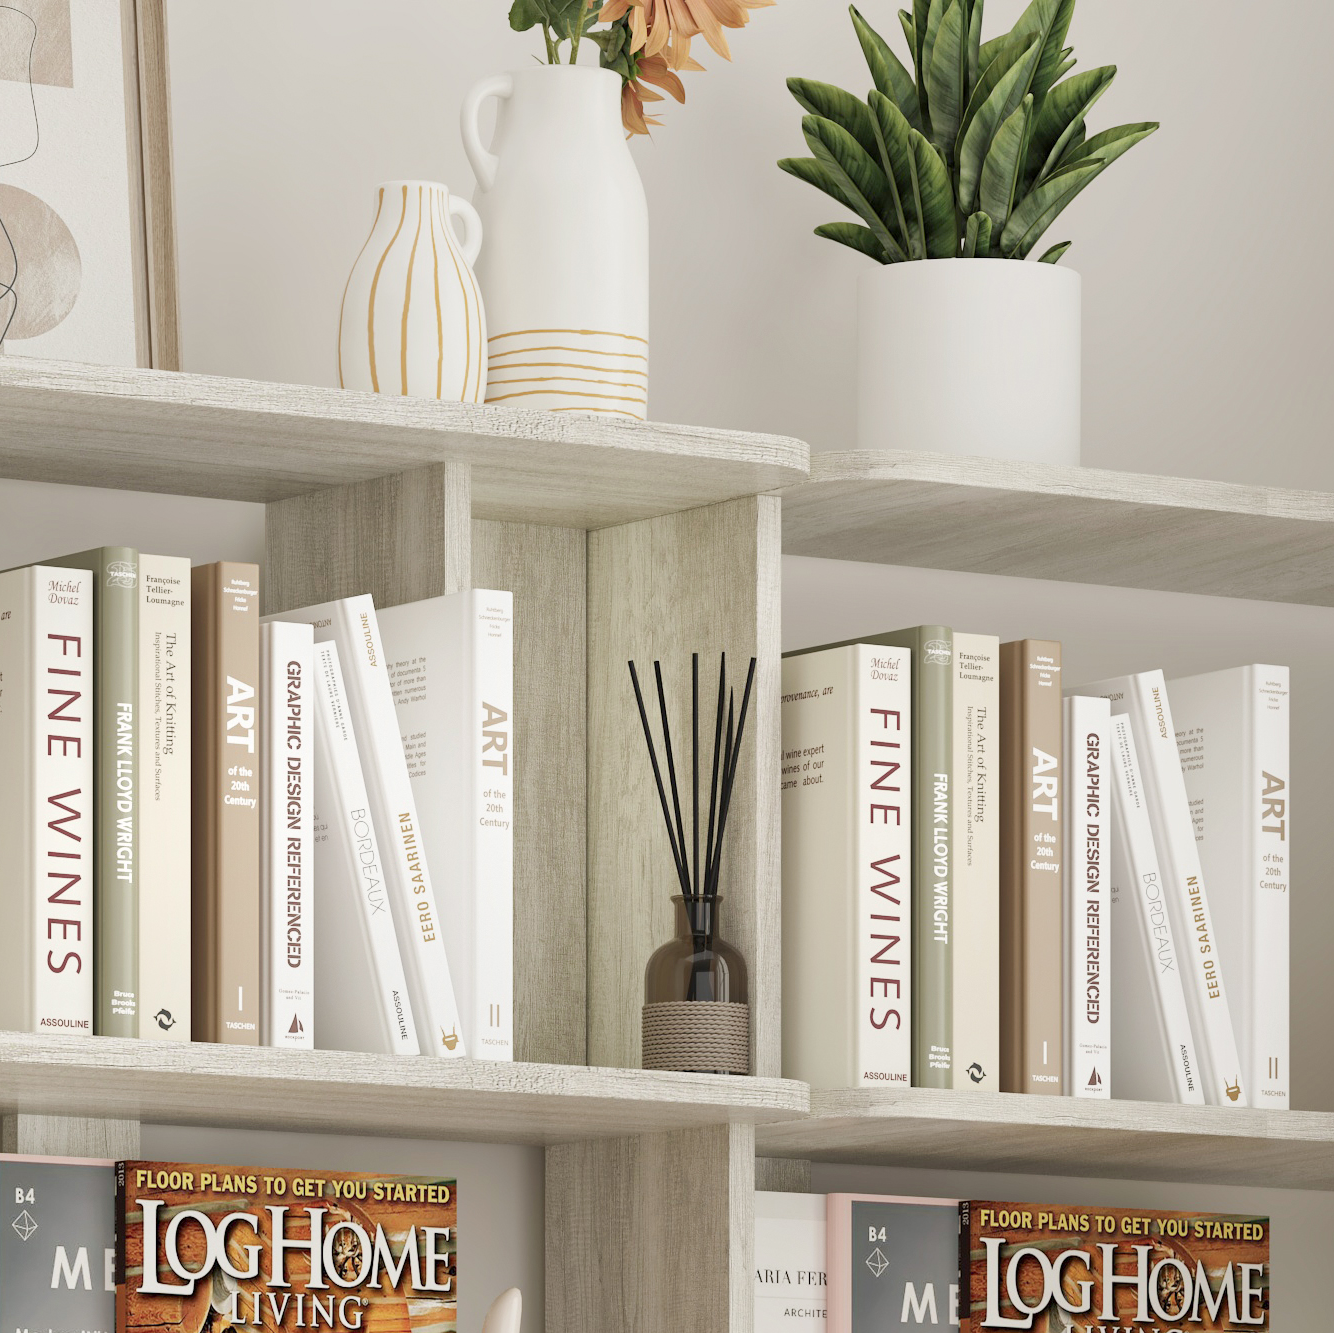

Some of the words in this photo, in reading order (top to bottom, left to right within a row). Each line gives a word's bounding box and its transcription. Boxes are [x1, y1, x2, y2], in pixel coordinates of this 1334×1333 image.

[48, 580, 82, 593] Michel
[48, 593, 79, 606] Dovaz
[146, 575, 181, 586] Françoise
[146, 596, 185, 607] Loumagne
[166, 632, 177, 657] The
[166, 660, 177, 682] Art
[47, 633, 82, 758] FINE
[166, 684, 177, 701] of
[226, 675, 255, 754] ART
[287, 661, 301, 750] GRAPHIC
[116, 702, 133, 756] FRANK
[162, 702, 177, 755] Knitting
[482, 701, 508, 776] ART
[116, 760, 133, 813] LLOYD
[228, 766, 238, 776] of
[239, 766, 252, 777] the
[231, 780, 250, 791] 20th
[287, 756, 301, 830] DESIGN
[870, 708, 901, 826] FINE
[1032, 747, 1058, 821] ART
[1086, 732, 1100, 818] GRAPHIC
[224, 794, 257, 809] Century
[933, 773, 948, 824] FRANK
[116, 817, 133, 883] WRIGHT
[350, 808, 386, 916] BORDEAUX
[398, 812, 426, 895] SAARINEN
[933, 827, 948, 877] LLOYD
[1086, 824, 1100, 893] DESIGN
[46, 787, 82, 975] WINES
[287, 837, 301, 968] REFERENCED
[417, 901, 436, 942] EERO
[933, 880, 948, 945] WRIGHT
[869, 854, 901, 1030] WINES
[1086, 899, 1100, 1024] REFERENCED
[40, 1018, 89, 1029] ASSOULINE
[226, 1021, 256, 1030] TASCHEN
[863, 1071, 908, 1082] ASSOULINE
[15, 1188, 35, 1204] B4
[136, 1169, 194, 1190] FLOOR
[200, 1173, 258, 1194] PLANS
[264, 1176, 287, 1195] TO
[296, 1178, 326, 1198] GET
[331, 1180, 367, 1199] YOU
[374, 1182, 450, 1203] STARTED
